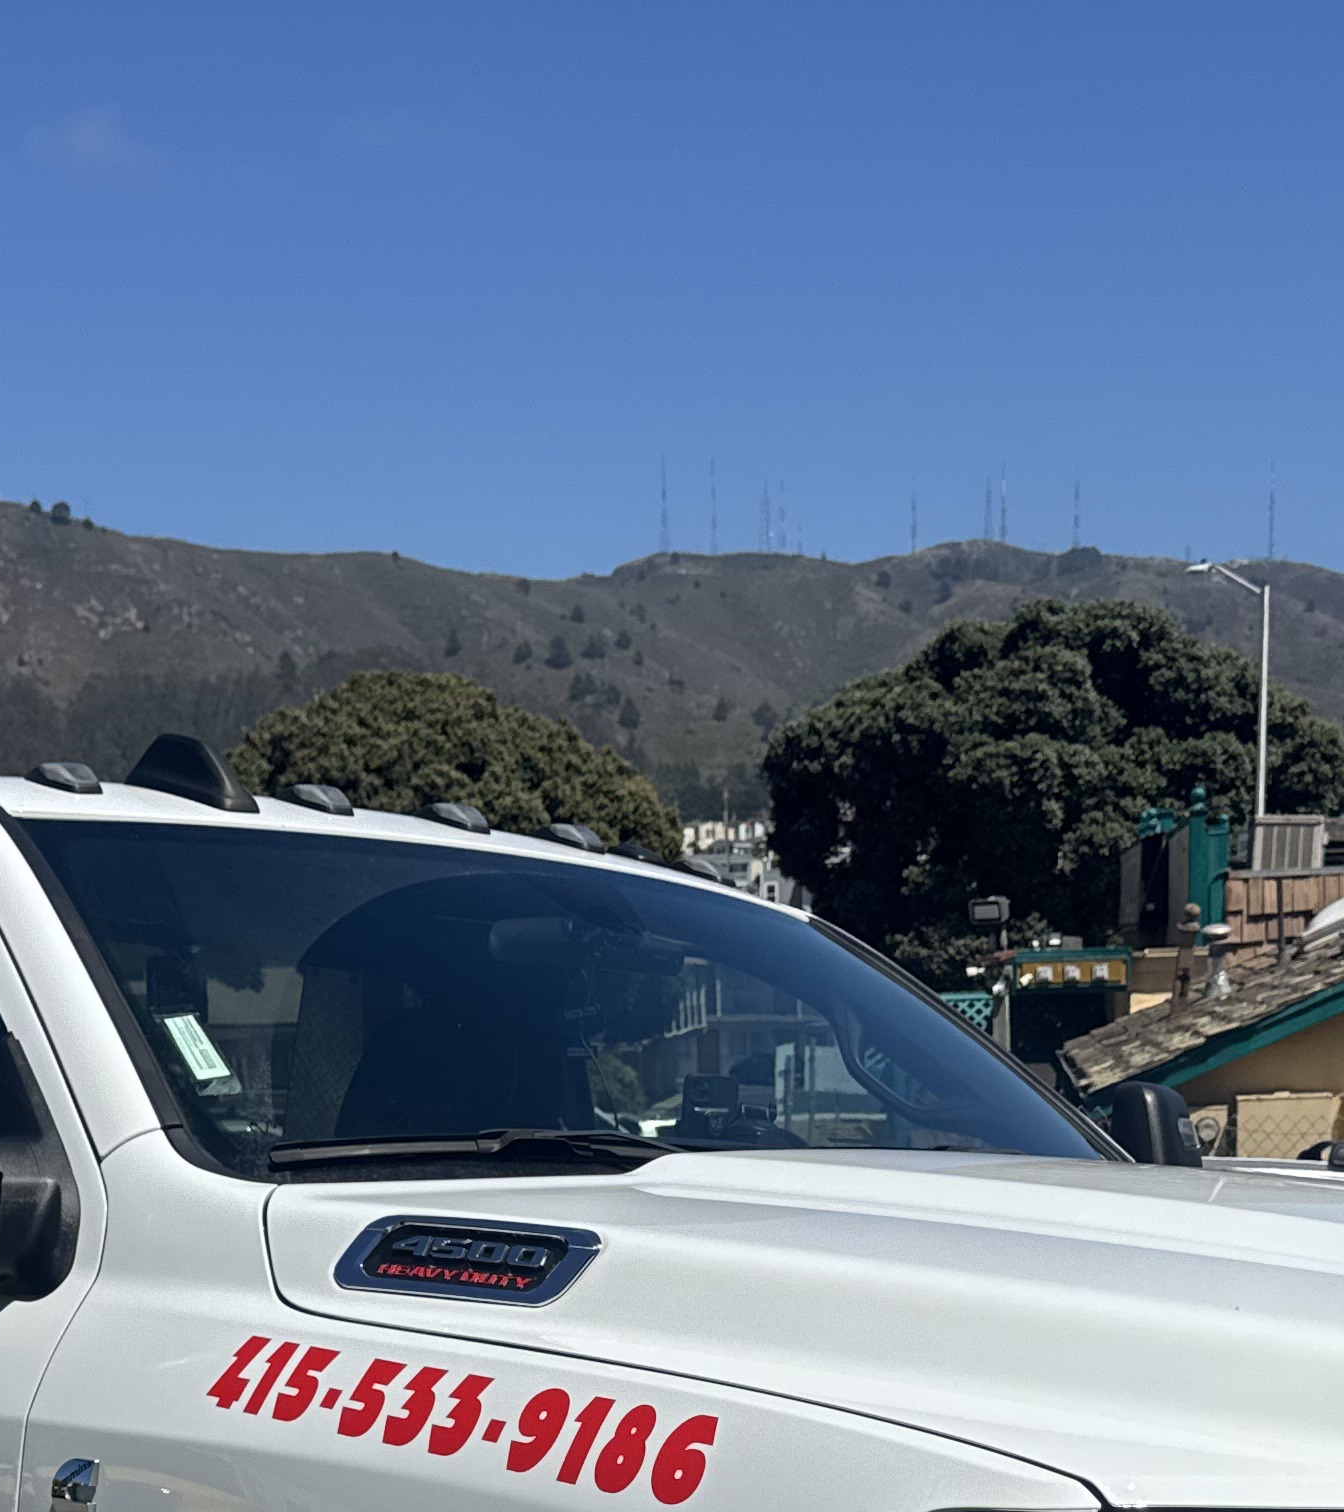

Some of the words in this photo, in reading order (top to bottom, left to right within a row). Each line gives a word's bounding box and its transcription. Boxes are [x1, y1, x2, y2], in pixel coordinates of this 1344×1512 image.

[391, 1234, 548, 1269] 4500
[375, 1262, 457, 1281] HEAVY
[459, 1269, 533, 1290] DUTY
[207, 1335, 719, 1506] 415-533-9186
